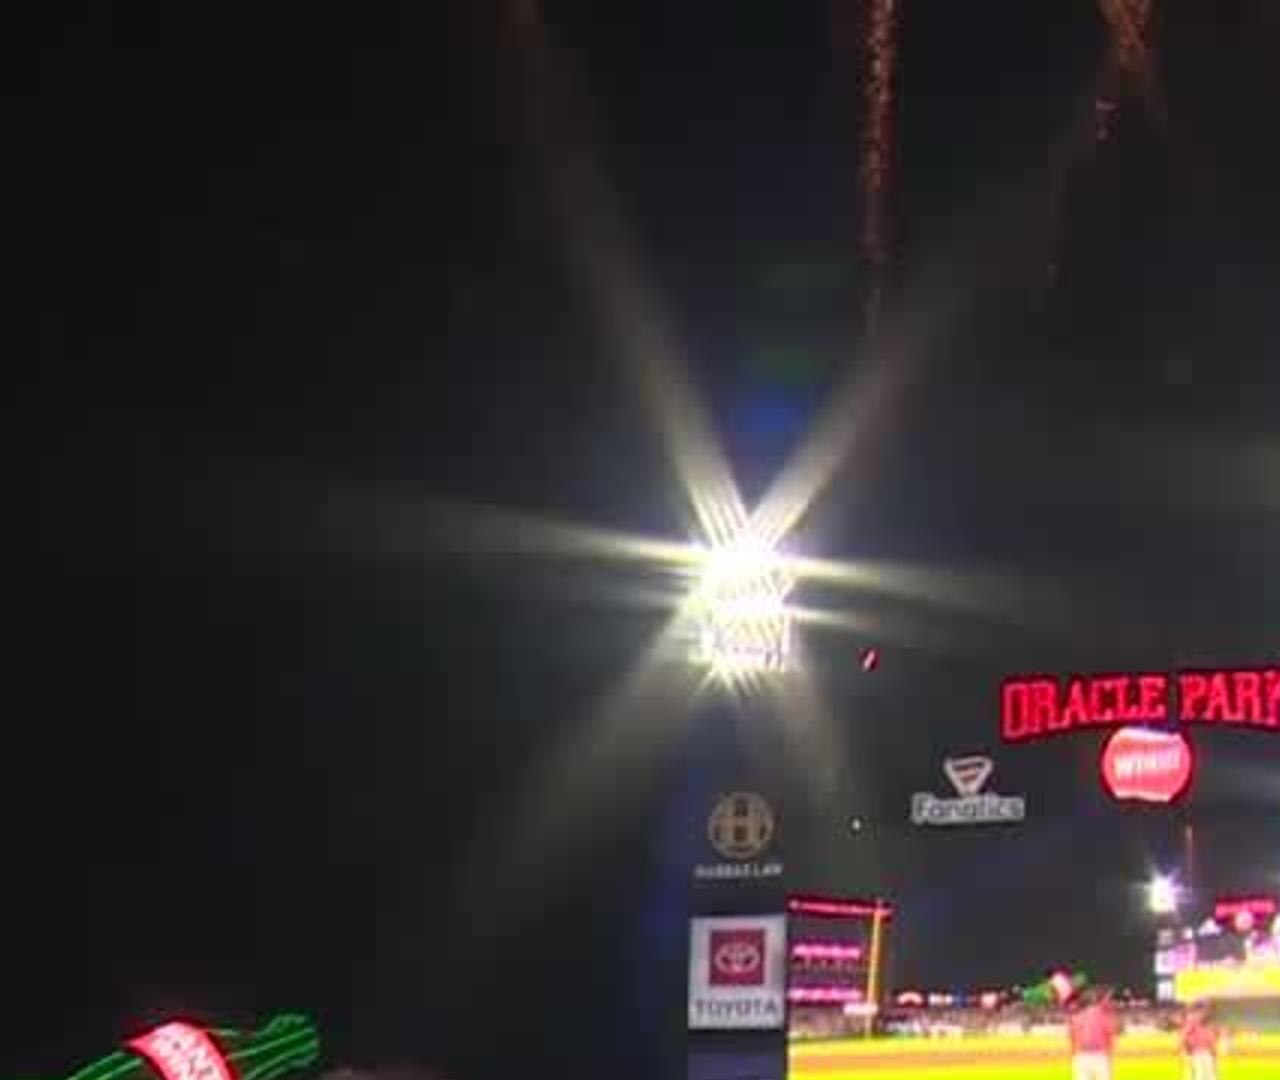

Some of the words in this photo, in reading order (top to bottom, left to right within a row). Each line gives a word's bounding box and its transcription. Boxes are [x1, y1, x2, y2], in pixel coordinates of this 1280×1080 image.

[1002, 676, 1168, 741] ORACLE
[911, 791, 1025, 824] Fanatics
[694, 1000, 779, 1017] TOYOTA
